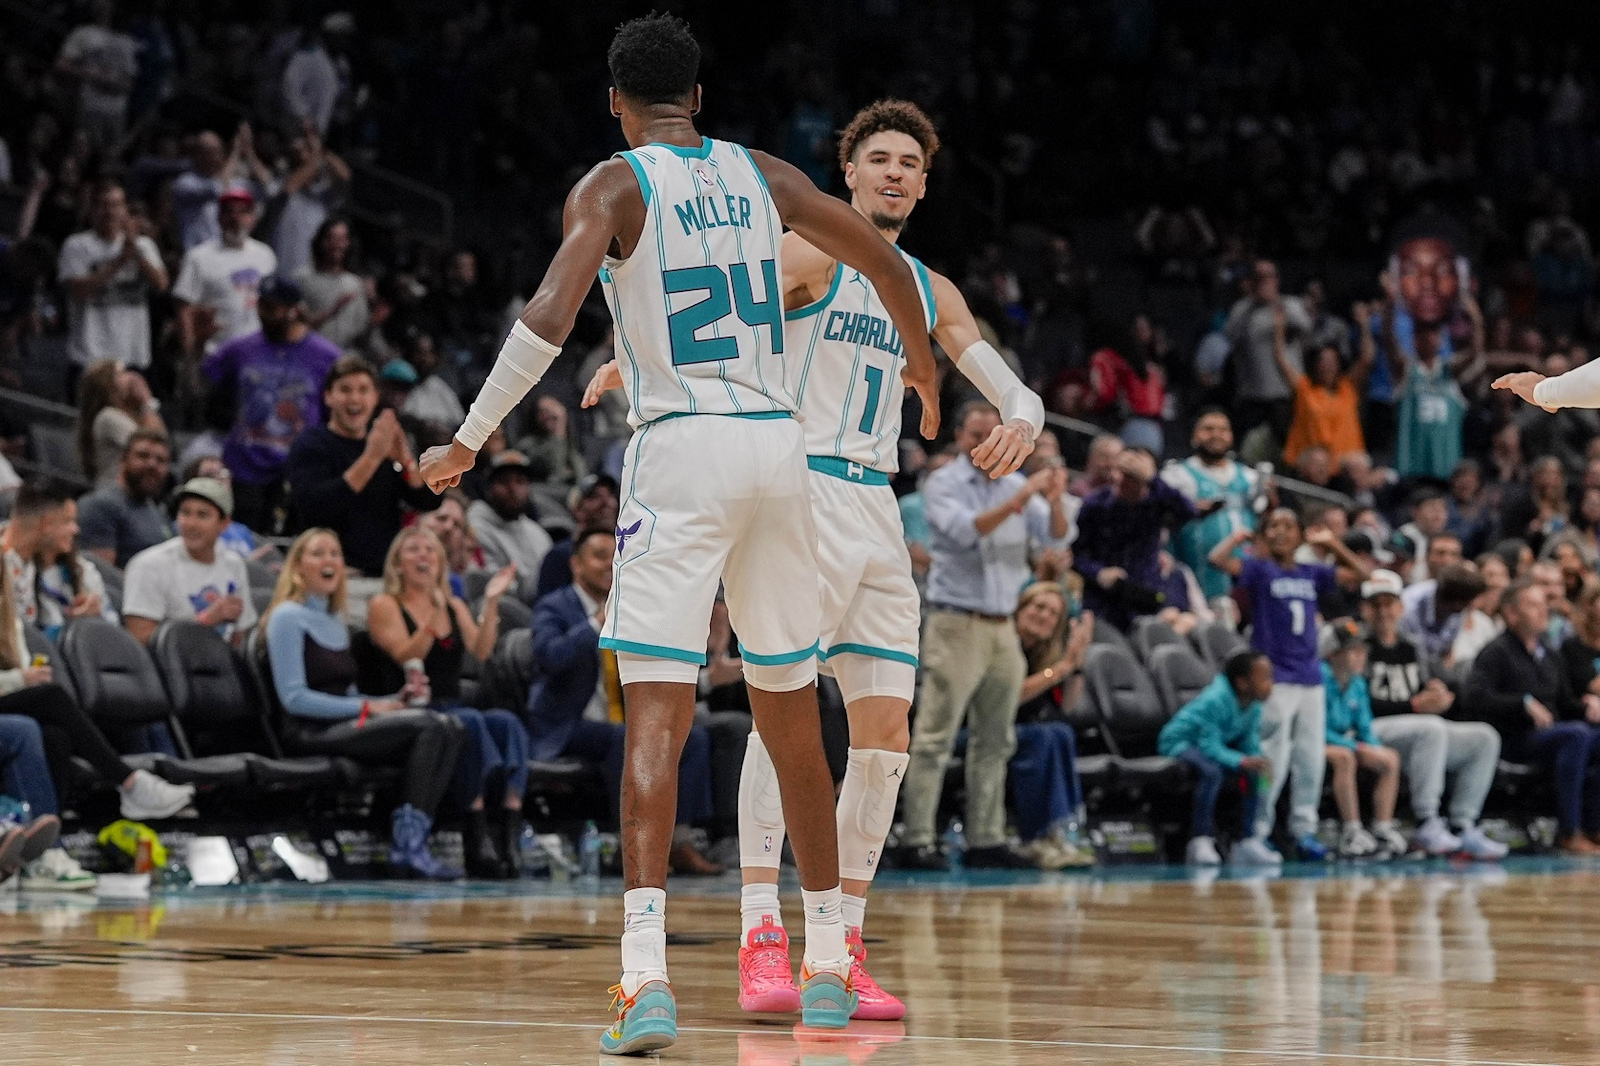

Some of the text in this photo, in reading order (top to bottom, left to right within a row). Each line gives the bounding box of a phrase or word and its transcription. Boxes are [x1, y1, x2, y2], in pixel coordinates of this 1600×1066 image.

[673, 195, 751, 236] MILLER
[663, 259, 783, 366] 24
[823, 311, 906, 358] CHARLO
[858, 364, 883, 435] 1
[1289, 599, 1305, 635] 1
